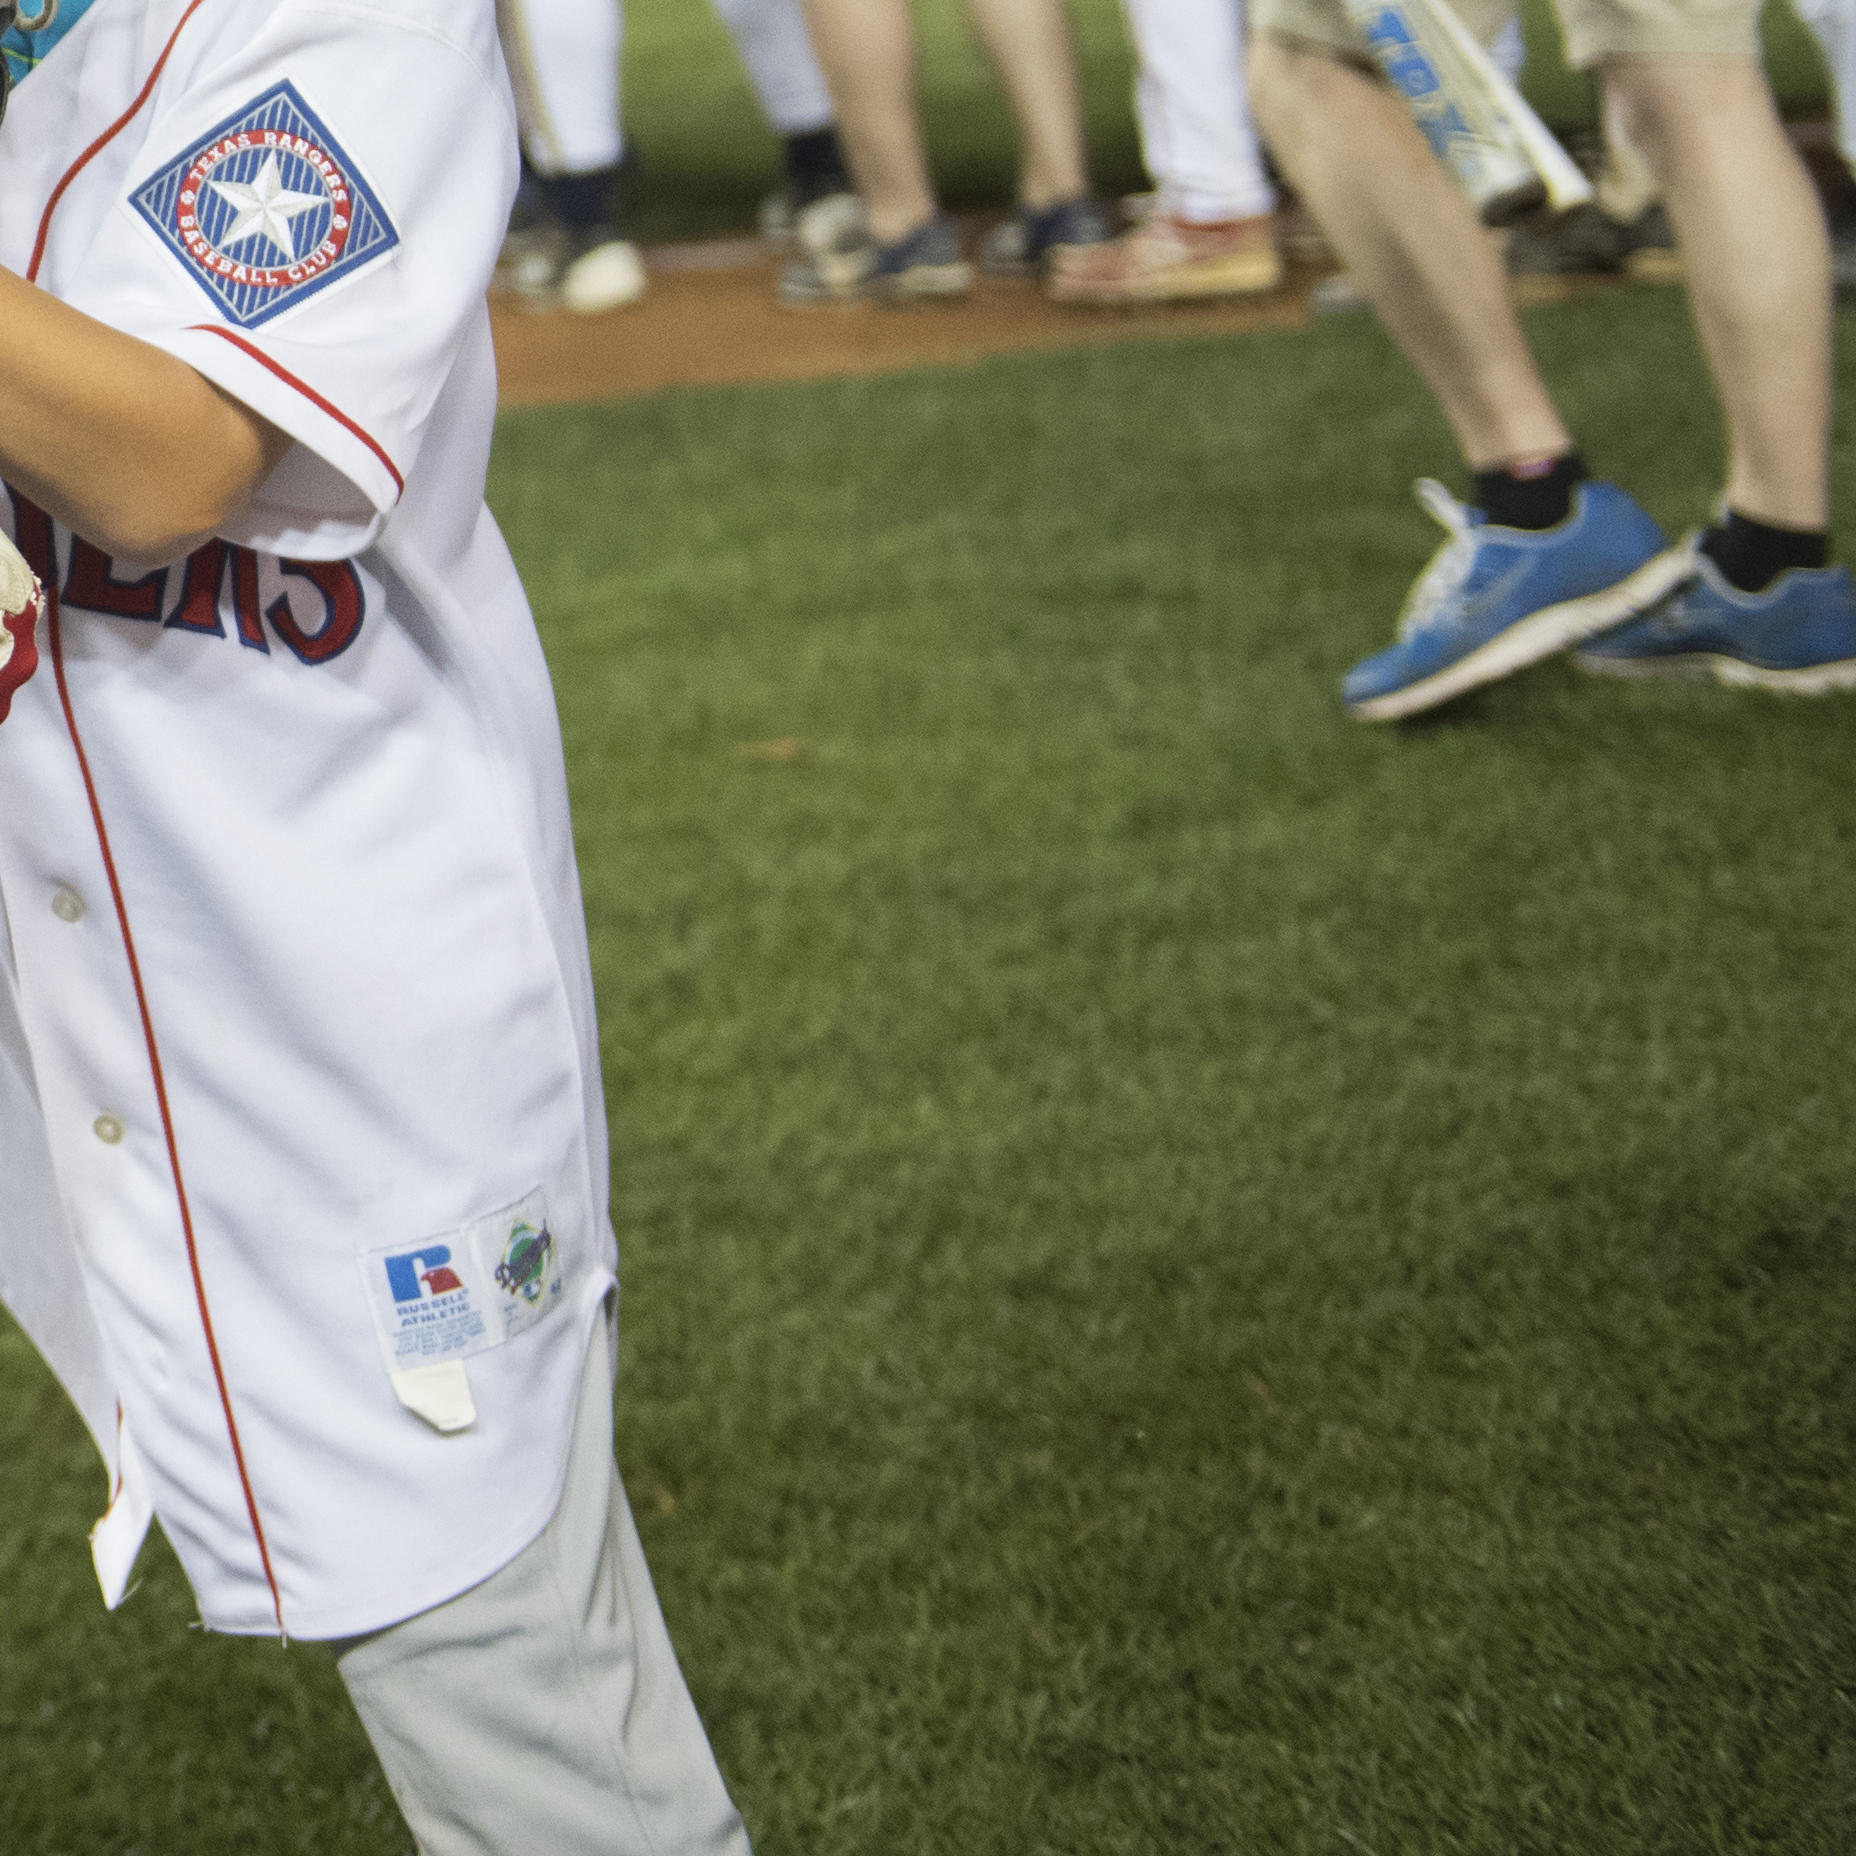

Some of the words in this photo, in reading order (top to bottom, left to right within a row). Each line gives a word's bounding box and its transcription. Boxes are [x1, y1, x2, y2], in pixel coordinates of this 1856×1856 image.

[190, 133, 251, 180] TEXAS
[264, 131, 348, 202] RANGERS
[180, 214, 278, 284] BASEBALL
[288, 239, 338, 280] CLUB
[396, 1293, 467, 1316] RUSSELL
[401, 1302, 471, 1327] ATHLETIC
